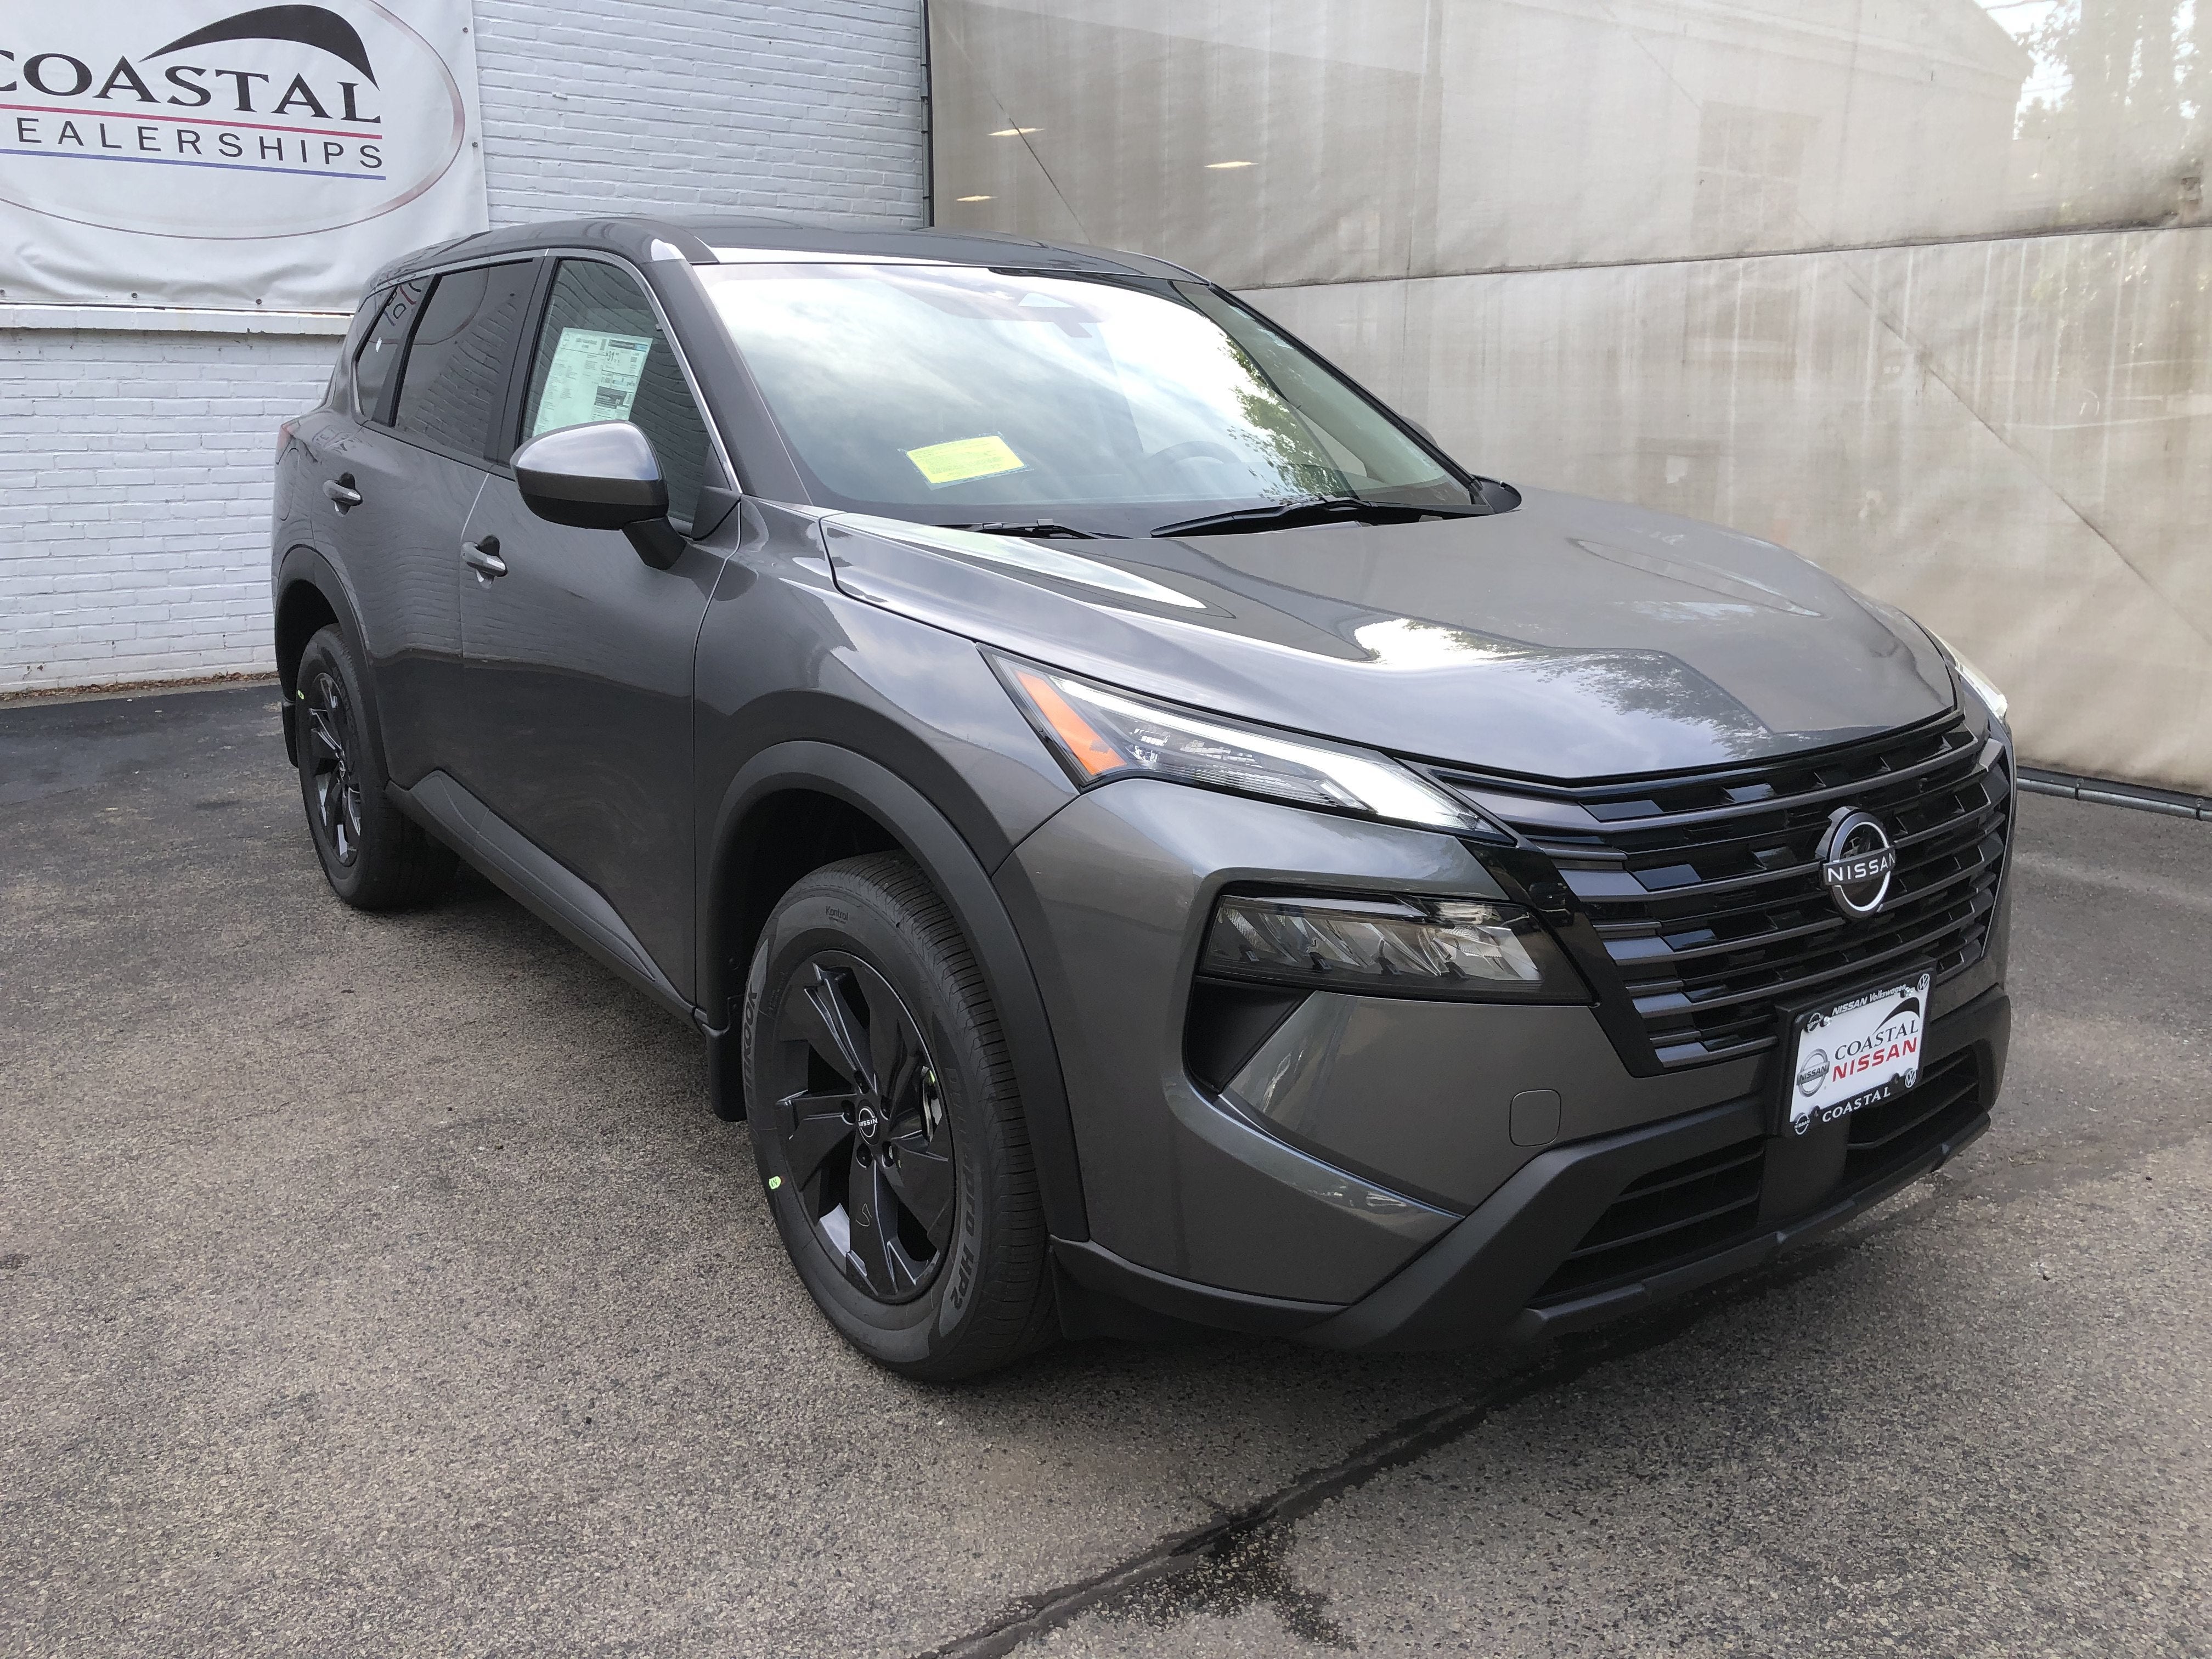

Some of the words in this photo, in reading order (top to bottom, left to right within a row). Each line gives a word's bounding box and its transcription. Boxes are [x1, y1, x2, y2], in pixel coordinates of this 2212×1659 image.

[17, 117, 383, 168] EALERSHIPS
[1828, 853, 1896, 882] NISSAN
[826, 906, 849, 921] Kontrol
[1832, 996, 1868, 1017] NISSAN
[1835, 1019, 1919, 1060] COASTAL
[1799, 1064, 1827, 1082] NISSAN
[1832, 1037, 1917, 1082] NISSAN
[1821, 1087, 1892, 1123] COASTAL
[951, 1241, 975, 1311] HP2
